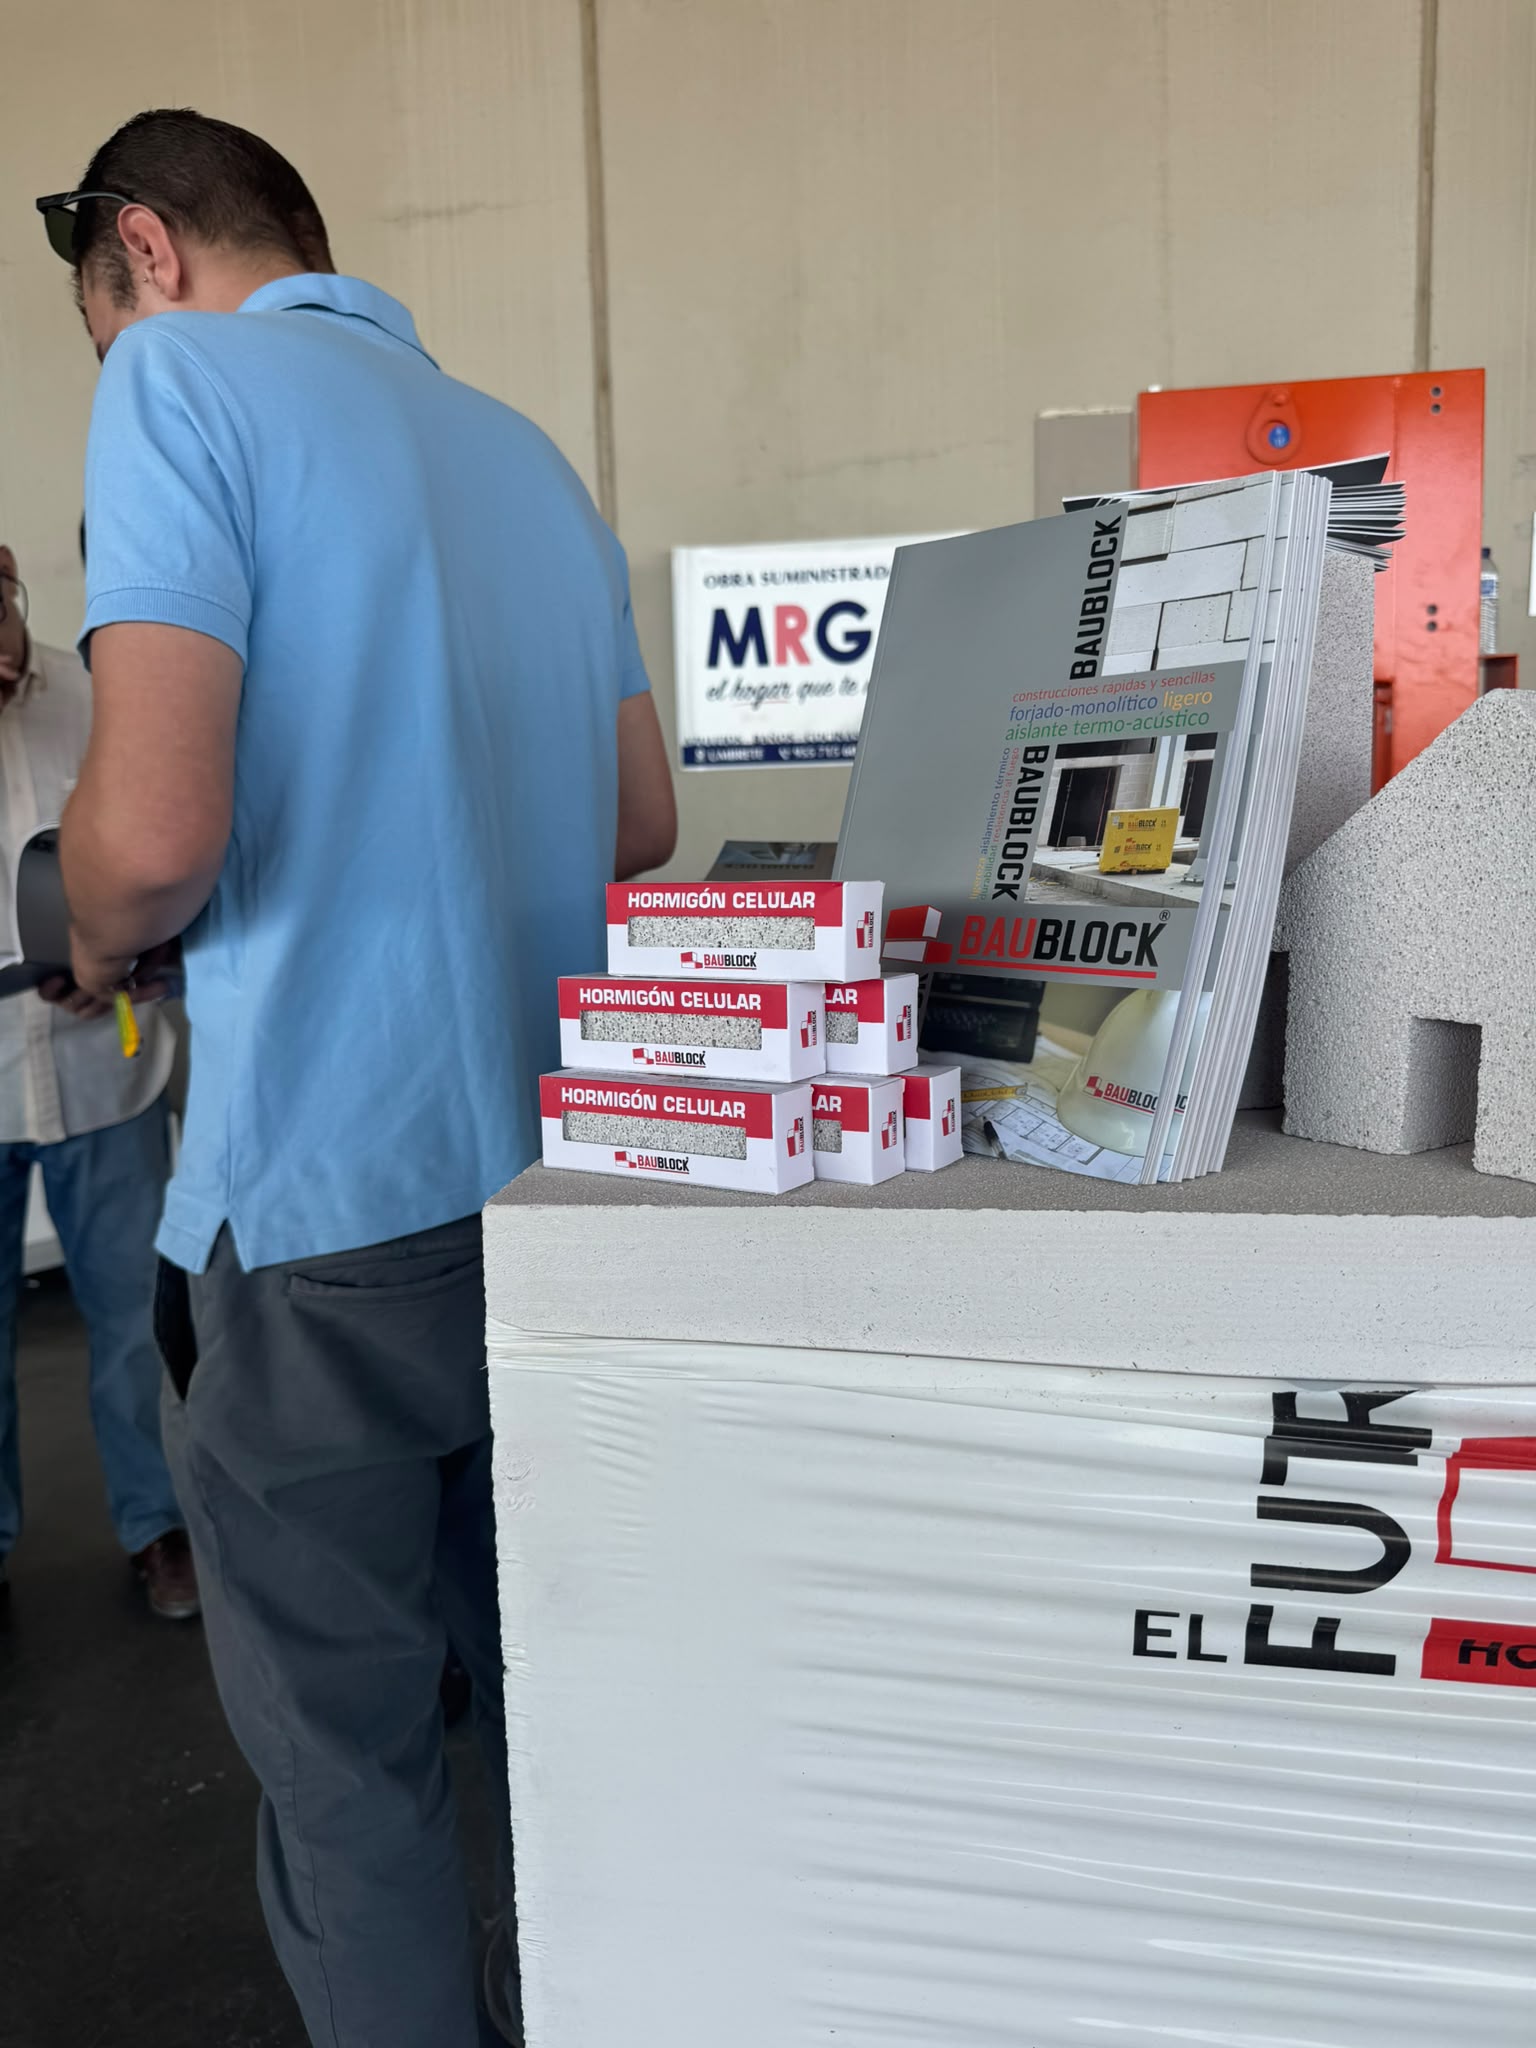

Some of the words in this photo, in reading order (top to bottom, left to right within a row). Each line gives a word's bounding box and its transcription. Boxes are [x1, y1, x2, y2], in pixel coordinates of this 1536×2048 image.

[703, 571, 755, 589] OBRA
[1069, 514, 1122, 680] BAUBLOCK
[707, 600, 872, 668] MRG
[731, 677, 792, 711] hogar
[796, 682, 834, 704] que
[1012, 685, 1098, 703] construcciones
[1102, 678, 1146, 696] rápidas
[1149, 679, 1157, 690] y
[1160, 671, 1216, 688] sencillas
[1009, 694, 1158, 723] forjado-monolítico
[1162, 690, 1213, 711] ligero
[1005, 722, 1068, 741] aislante
[1073, 709, 1210, 736] termo-acústico
[980, 792, 1001, 855] aislamiento
[994, 747, 1010, 789] térmico
[980, 845, 998, 900] durabilidad
[994, 790, 1010, 843] resistencia
[1006, 747, 1019, 777] fuego
[991, 745, 1050, 901] BAUBLOCK
[628, 888, 725, 909] HORMIGÓN
[732, 891, 816, 909] CELULAR
[959, 915, 1168, 968] BAUBLOCK
[704, 953, 757, 968] BAUBLOCK
[579, 986, 675, 1007] HORMIGÓN
[681, 991, 762, 1011] CELULAR
[655, 1050, 706, 1066] BAUBLOCK
[561, 1087, 657, 1111] HORMIGÓN
[663, 1095, 746, 1119] CELULAR
[637, 1153, 689, 1172] BAUBLOCK
[1132, 1609, 1228, 1663] EL
